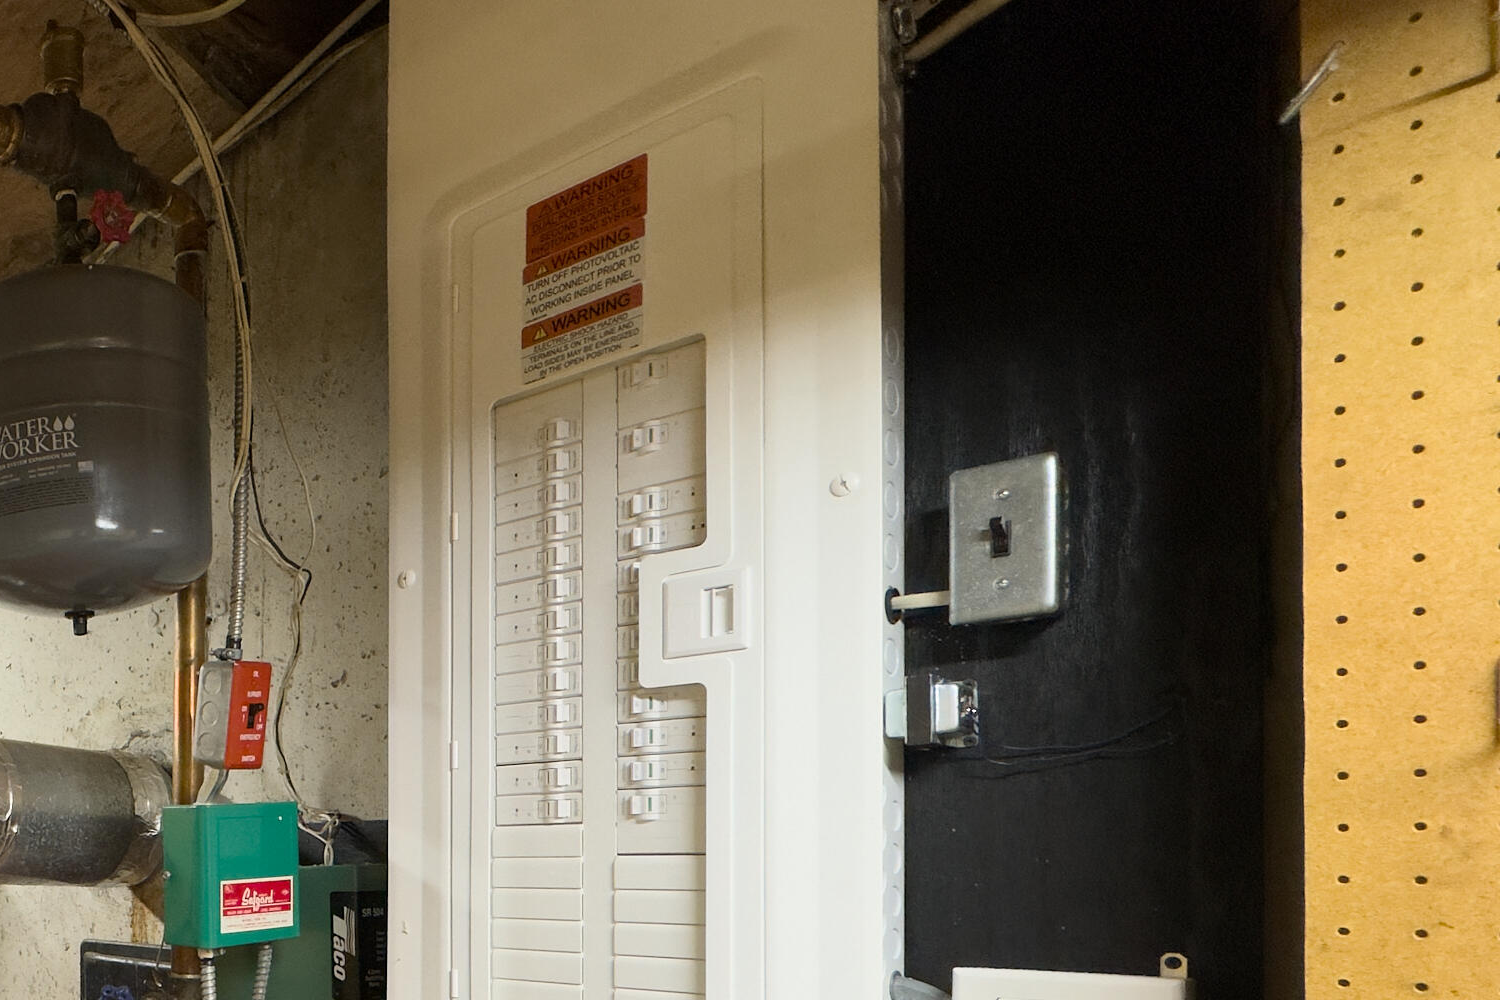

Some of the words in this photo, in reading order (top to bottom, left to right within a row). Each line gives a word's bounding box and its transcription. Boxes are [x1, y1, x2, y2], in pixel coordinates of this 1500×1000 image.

[555, 164, 634, 209] WARNING
[526, 277, 550, 293] TURN
[552, 268, 569, 284] OFF
[571, 241, 640, 275] PHOTOVOLTAIC
[551, 226, 631, 269] WARNING
[525, 295, 538, 306] AC
[538, 271, 596, 301] DISCONNECT
[597, 259, 626, 276] PRIOR
[628, 253, 642, 267] TO
[530, 293, 572, 315] WORKING
[573, 280, 603, 297] INSIDE
[605, 270, 635, 288] PANEL
[551, 292, 631, 333] WARNING
[524, 361, 544, 374] LOAD
[544, 354, 566, 367] SIDES
[595, 327, 640, 349] ENERGIZED
[529, 343, 569, 363] TERMINALS
[618, 321, 635, 333] AND
[533, 336, 568, 353] ELECTRIC
[549, 362, 562, 373] THE
[563, 356, 585, 369] OPEN
[586, 344, 622, 361] POSITION
